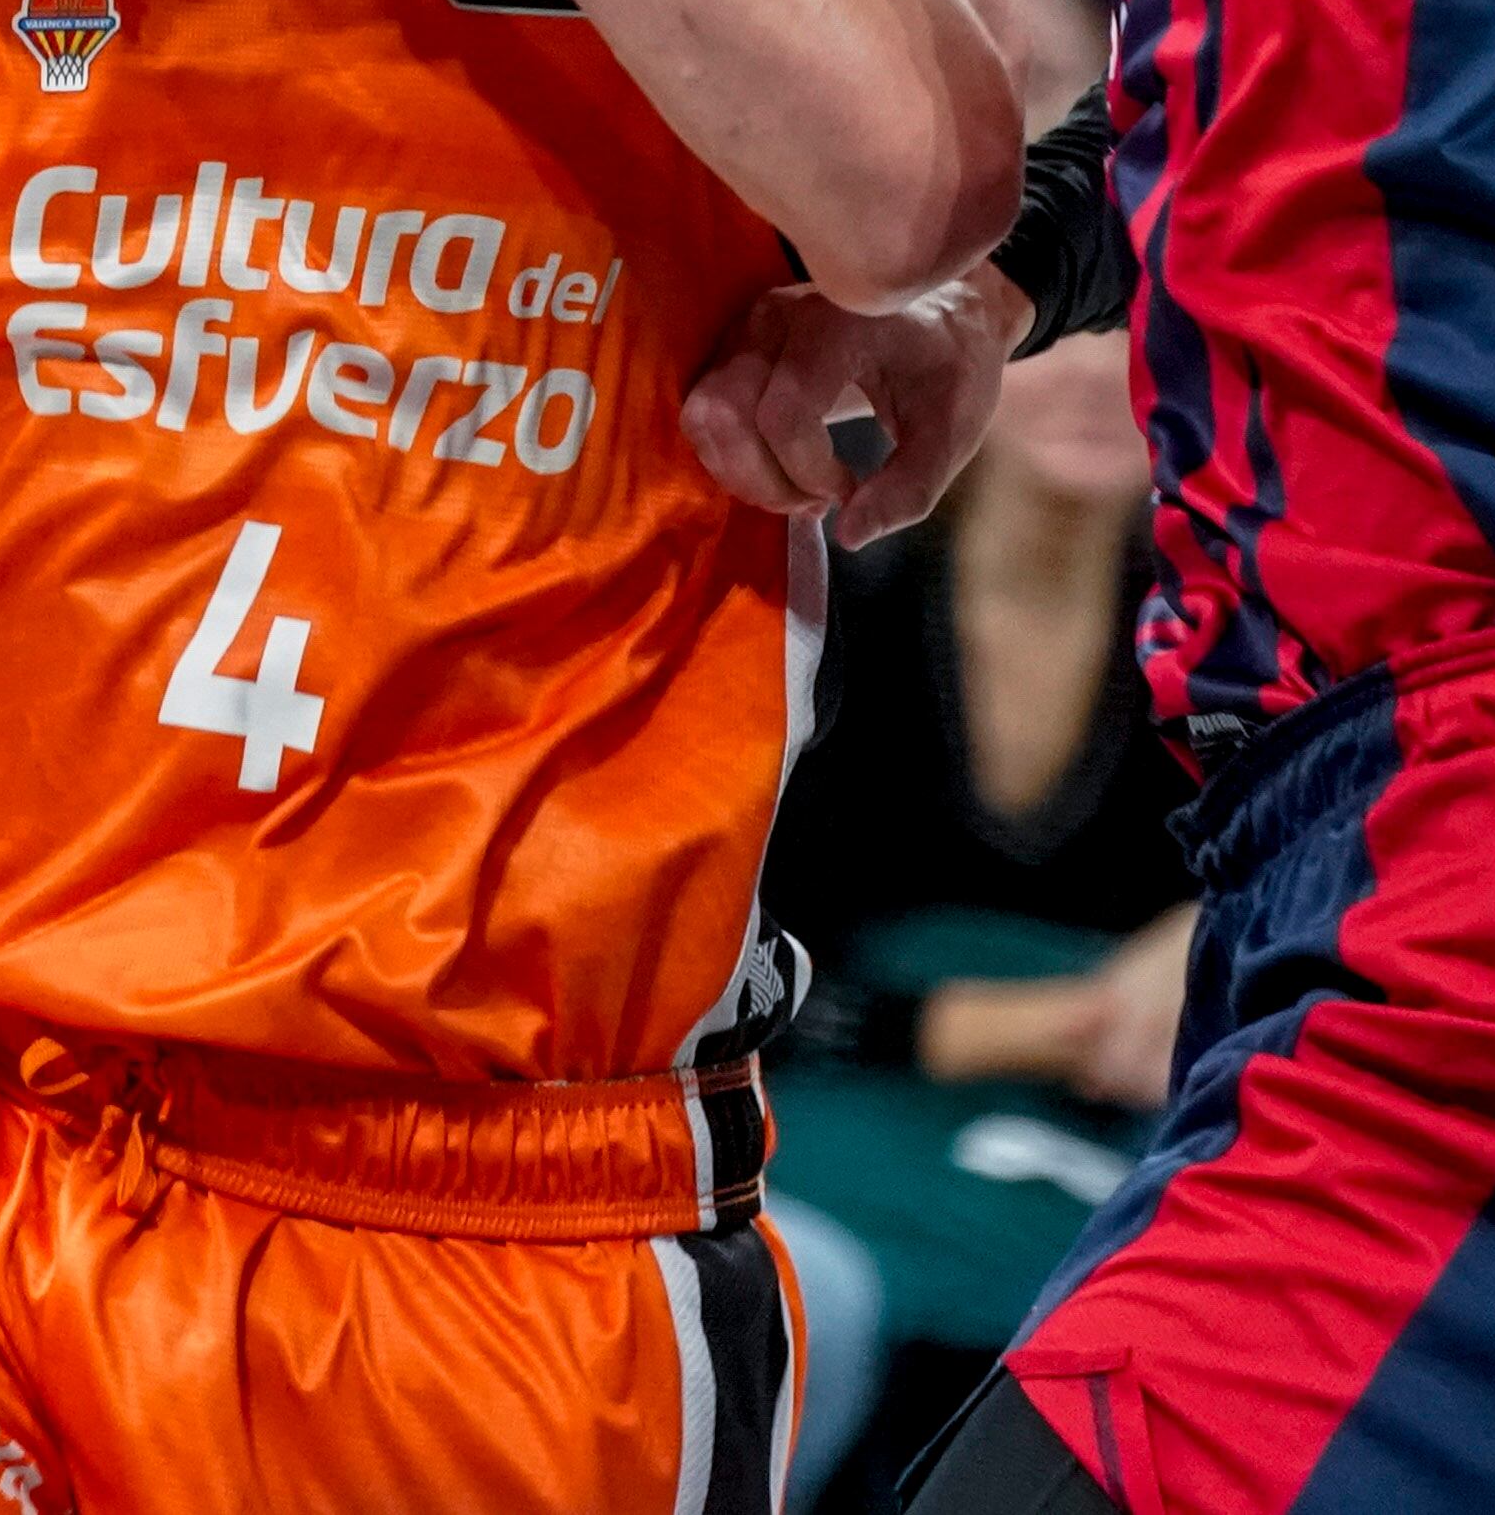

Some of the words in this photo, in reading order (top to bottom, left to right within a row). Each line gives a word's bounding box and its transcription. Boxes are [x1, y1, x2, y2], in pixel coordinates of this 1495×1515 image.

[25, 18, 73, 29] VALENCIA
[9, 161, 506, 314] Cultura
[508, 252, 623, 325] del
[6, 297, 597, 475] Esfuerzo
[158, 519, 325, 793] 4
